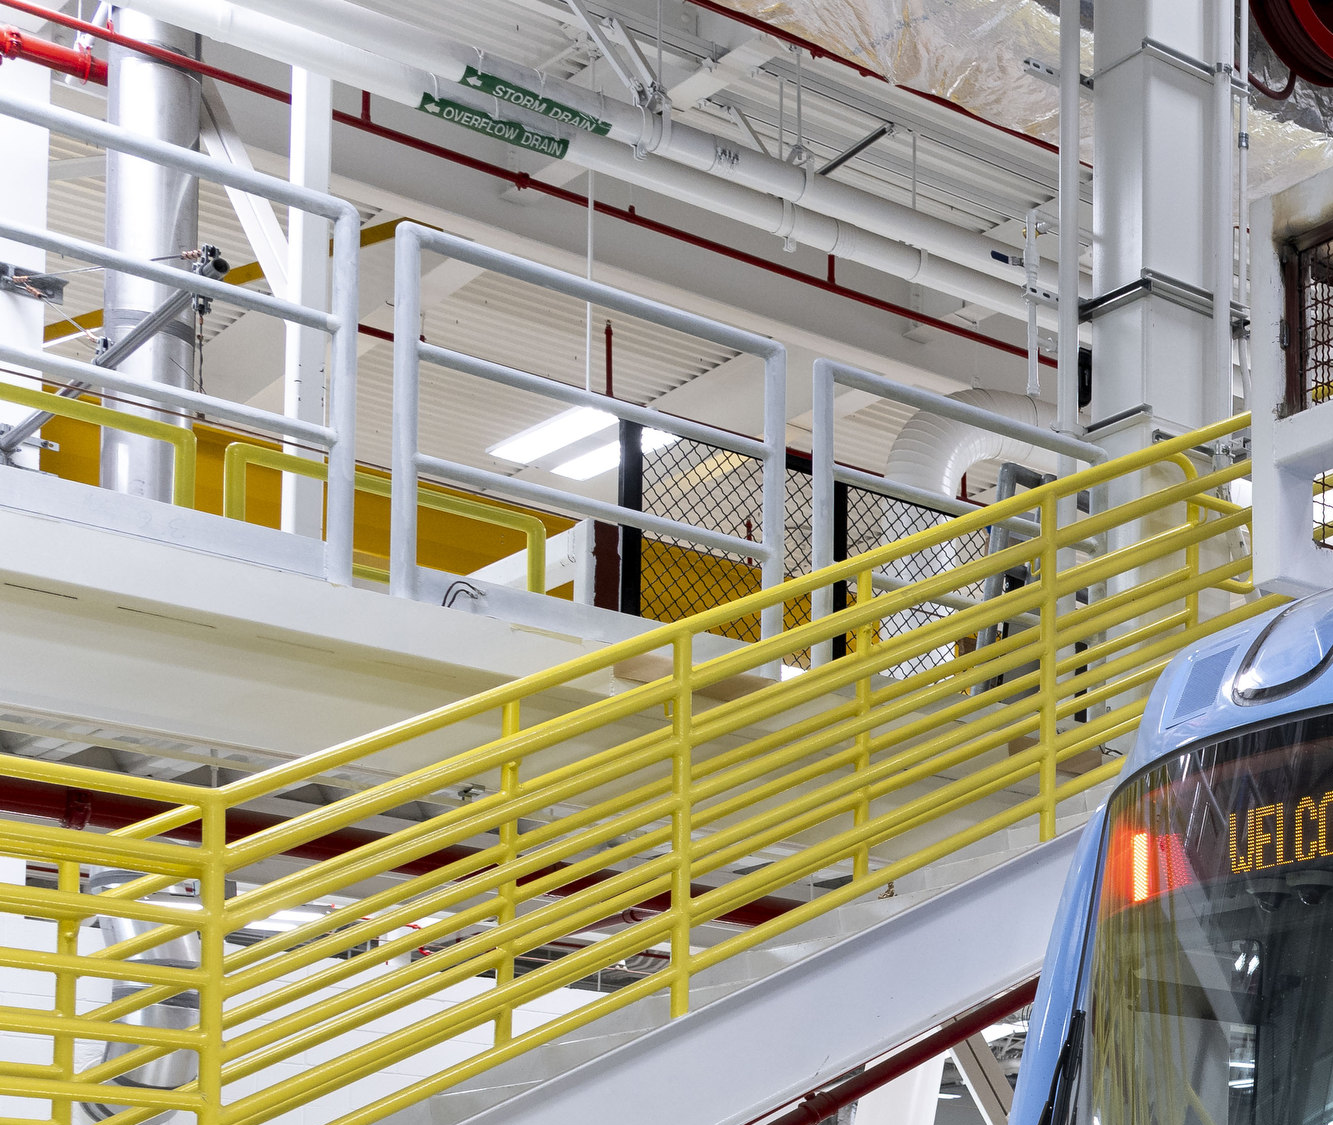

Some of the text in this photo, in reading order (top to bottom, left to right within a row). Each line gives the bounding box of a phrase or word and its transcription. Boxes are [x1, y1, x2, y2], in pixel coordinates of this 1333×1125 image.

[442, 107, 563, 156] OVERFLOW DRAIN
[492, 85, 596, 132] STORM DRAIN
